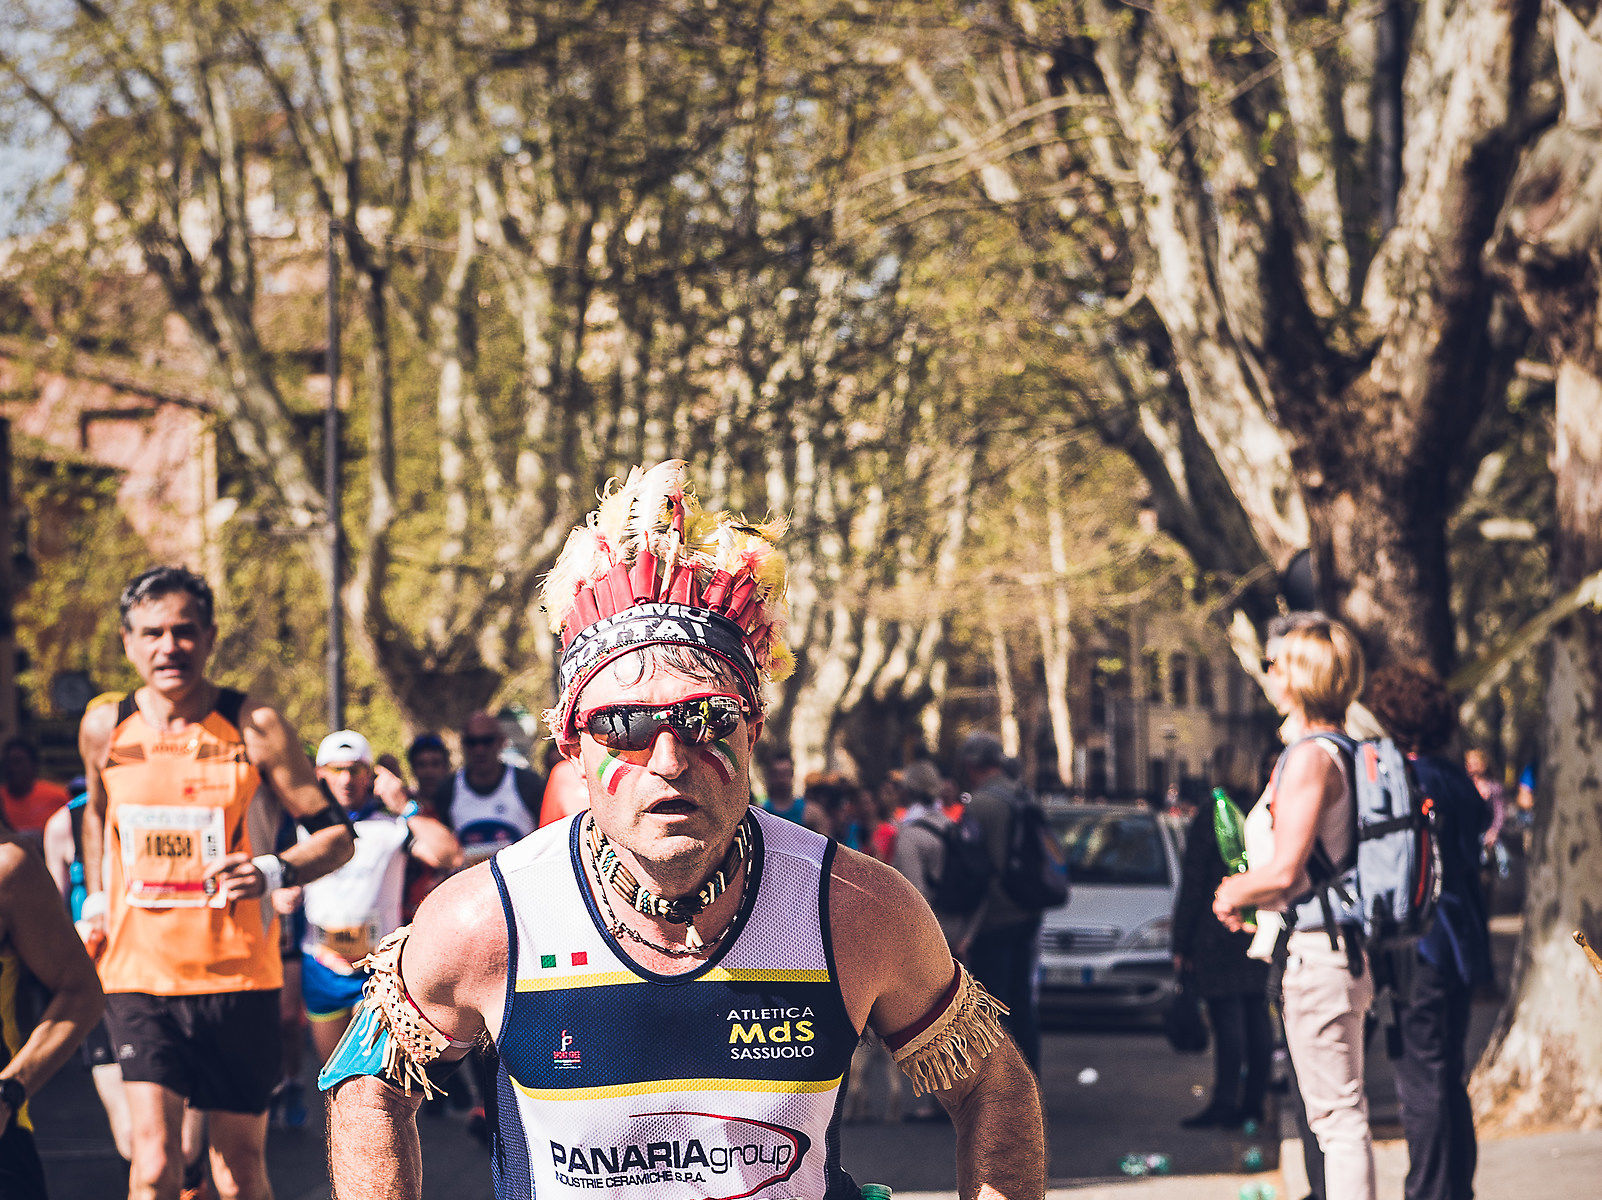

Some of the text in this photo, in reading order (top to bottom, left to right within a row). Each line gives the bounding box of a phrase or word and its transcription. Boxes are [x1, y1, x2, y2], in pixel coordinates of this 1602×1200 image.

[726, 1006, 815, 1020] ATLETICA
[728, 1020, 815, 1044] MdS
[730, 1045, 815, 1060] SASSUOLO
[605, 1171, 674, 1187] CERAMICHE
[674, 1171, 706, 1183] S.P.A.
